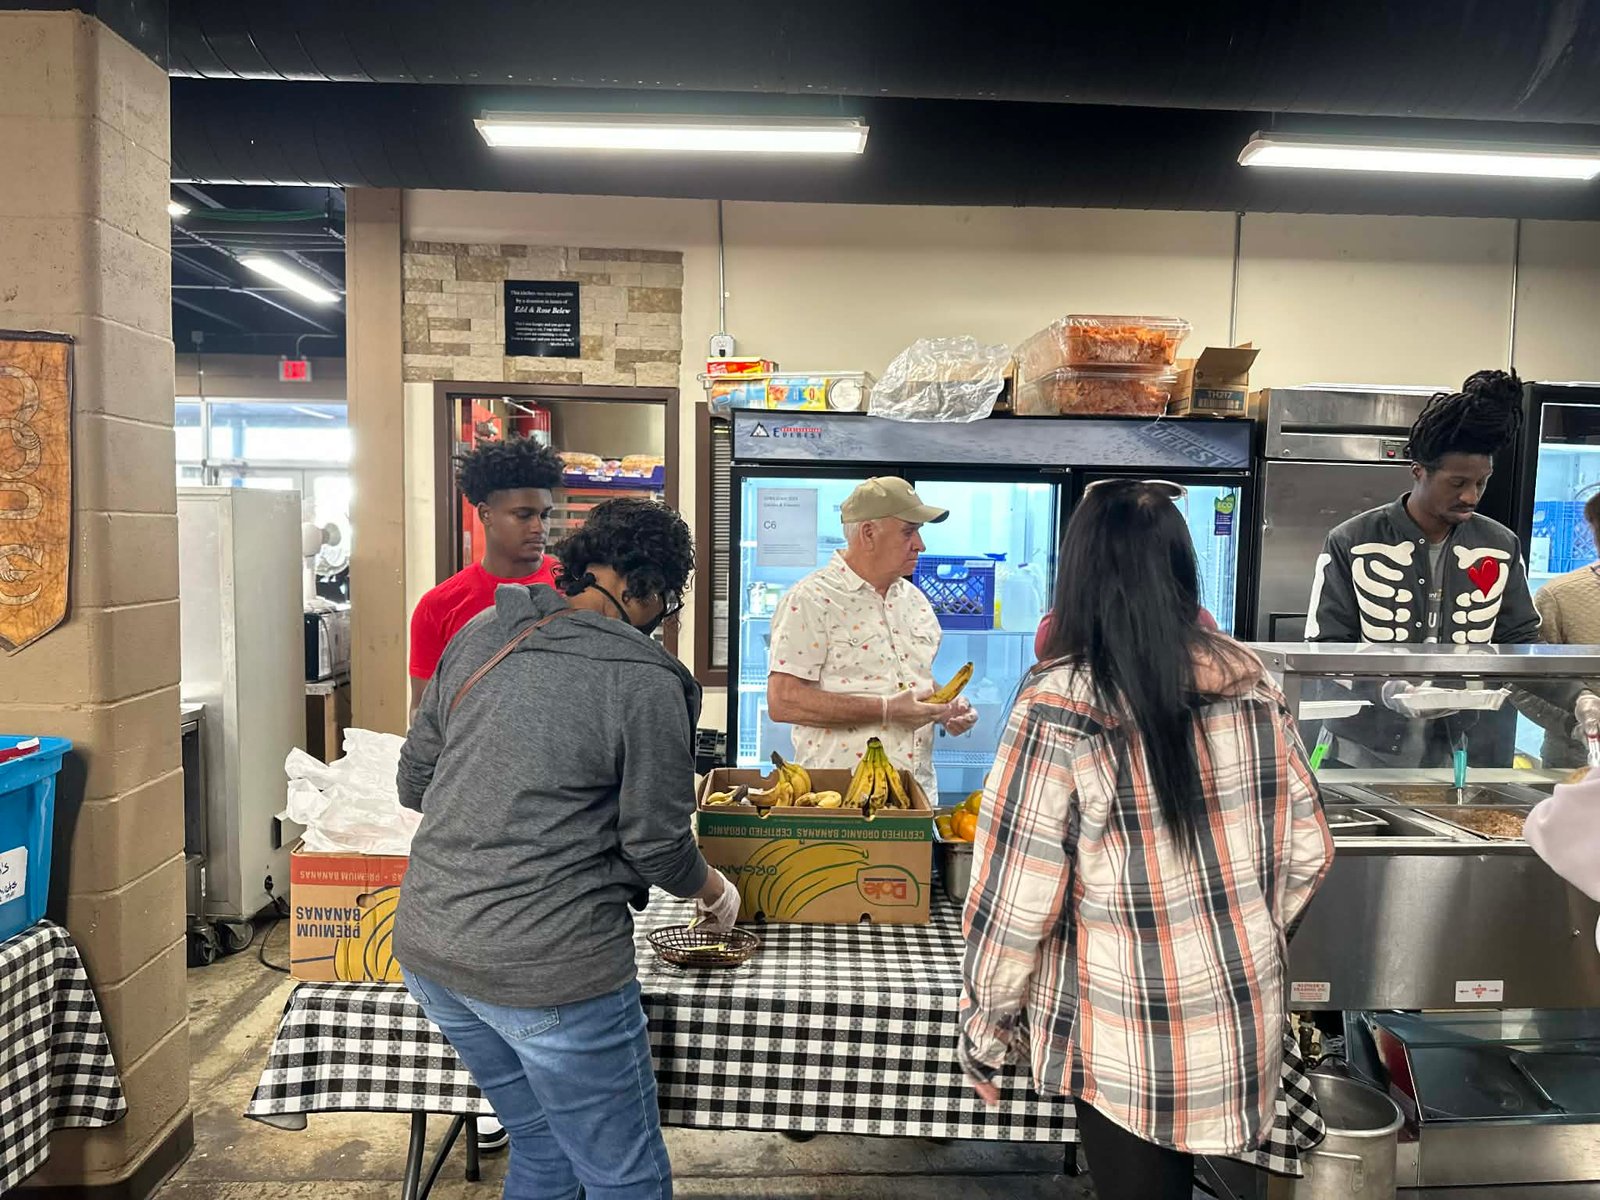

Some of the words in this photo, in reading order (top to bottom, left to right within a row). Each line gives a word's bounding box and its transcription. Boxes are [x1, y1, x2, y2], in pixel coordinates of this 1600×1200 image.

[535, 306, 551, 314] Rose
[763, 520, 777, 530] C6
[707, 825, 747, 835] ORGANIC
[749, 826, 792, 837] CERTIFIED
[796, 827, 840, 838] BANANAS
[841, 828, 880, 839] ORGANIC
[881, 829, 925, 840] CERTIFIED
[300, 870, 340, 881] BANANAS
[714, 864, 777, 876] ORGAN
[340, 871, 381, 882] PREMIUM
[863, 881, 907, 900] Dole
[296, 905, 361, 921] BANANAS
[297, 923, 361, 938] PREMIUM
